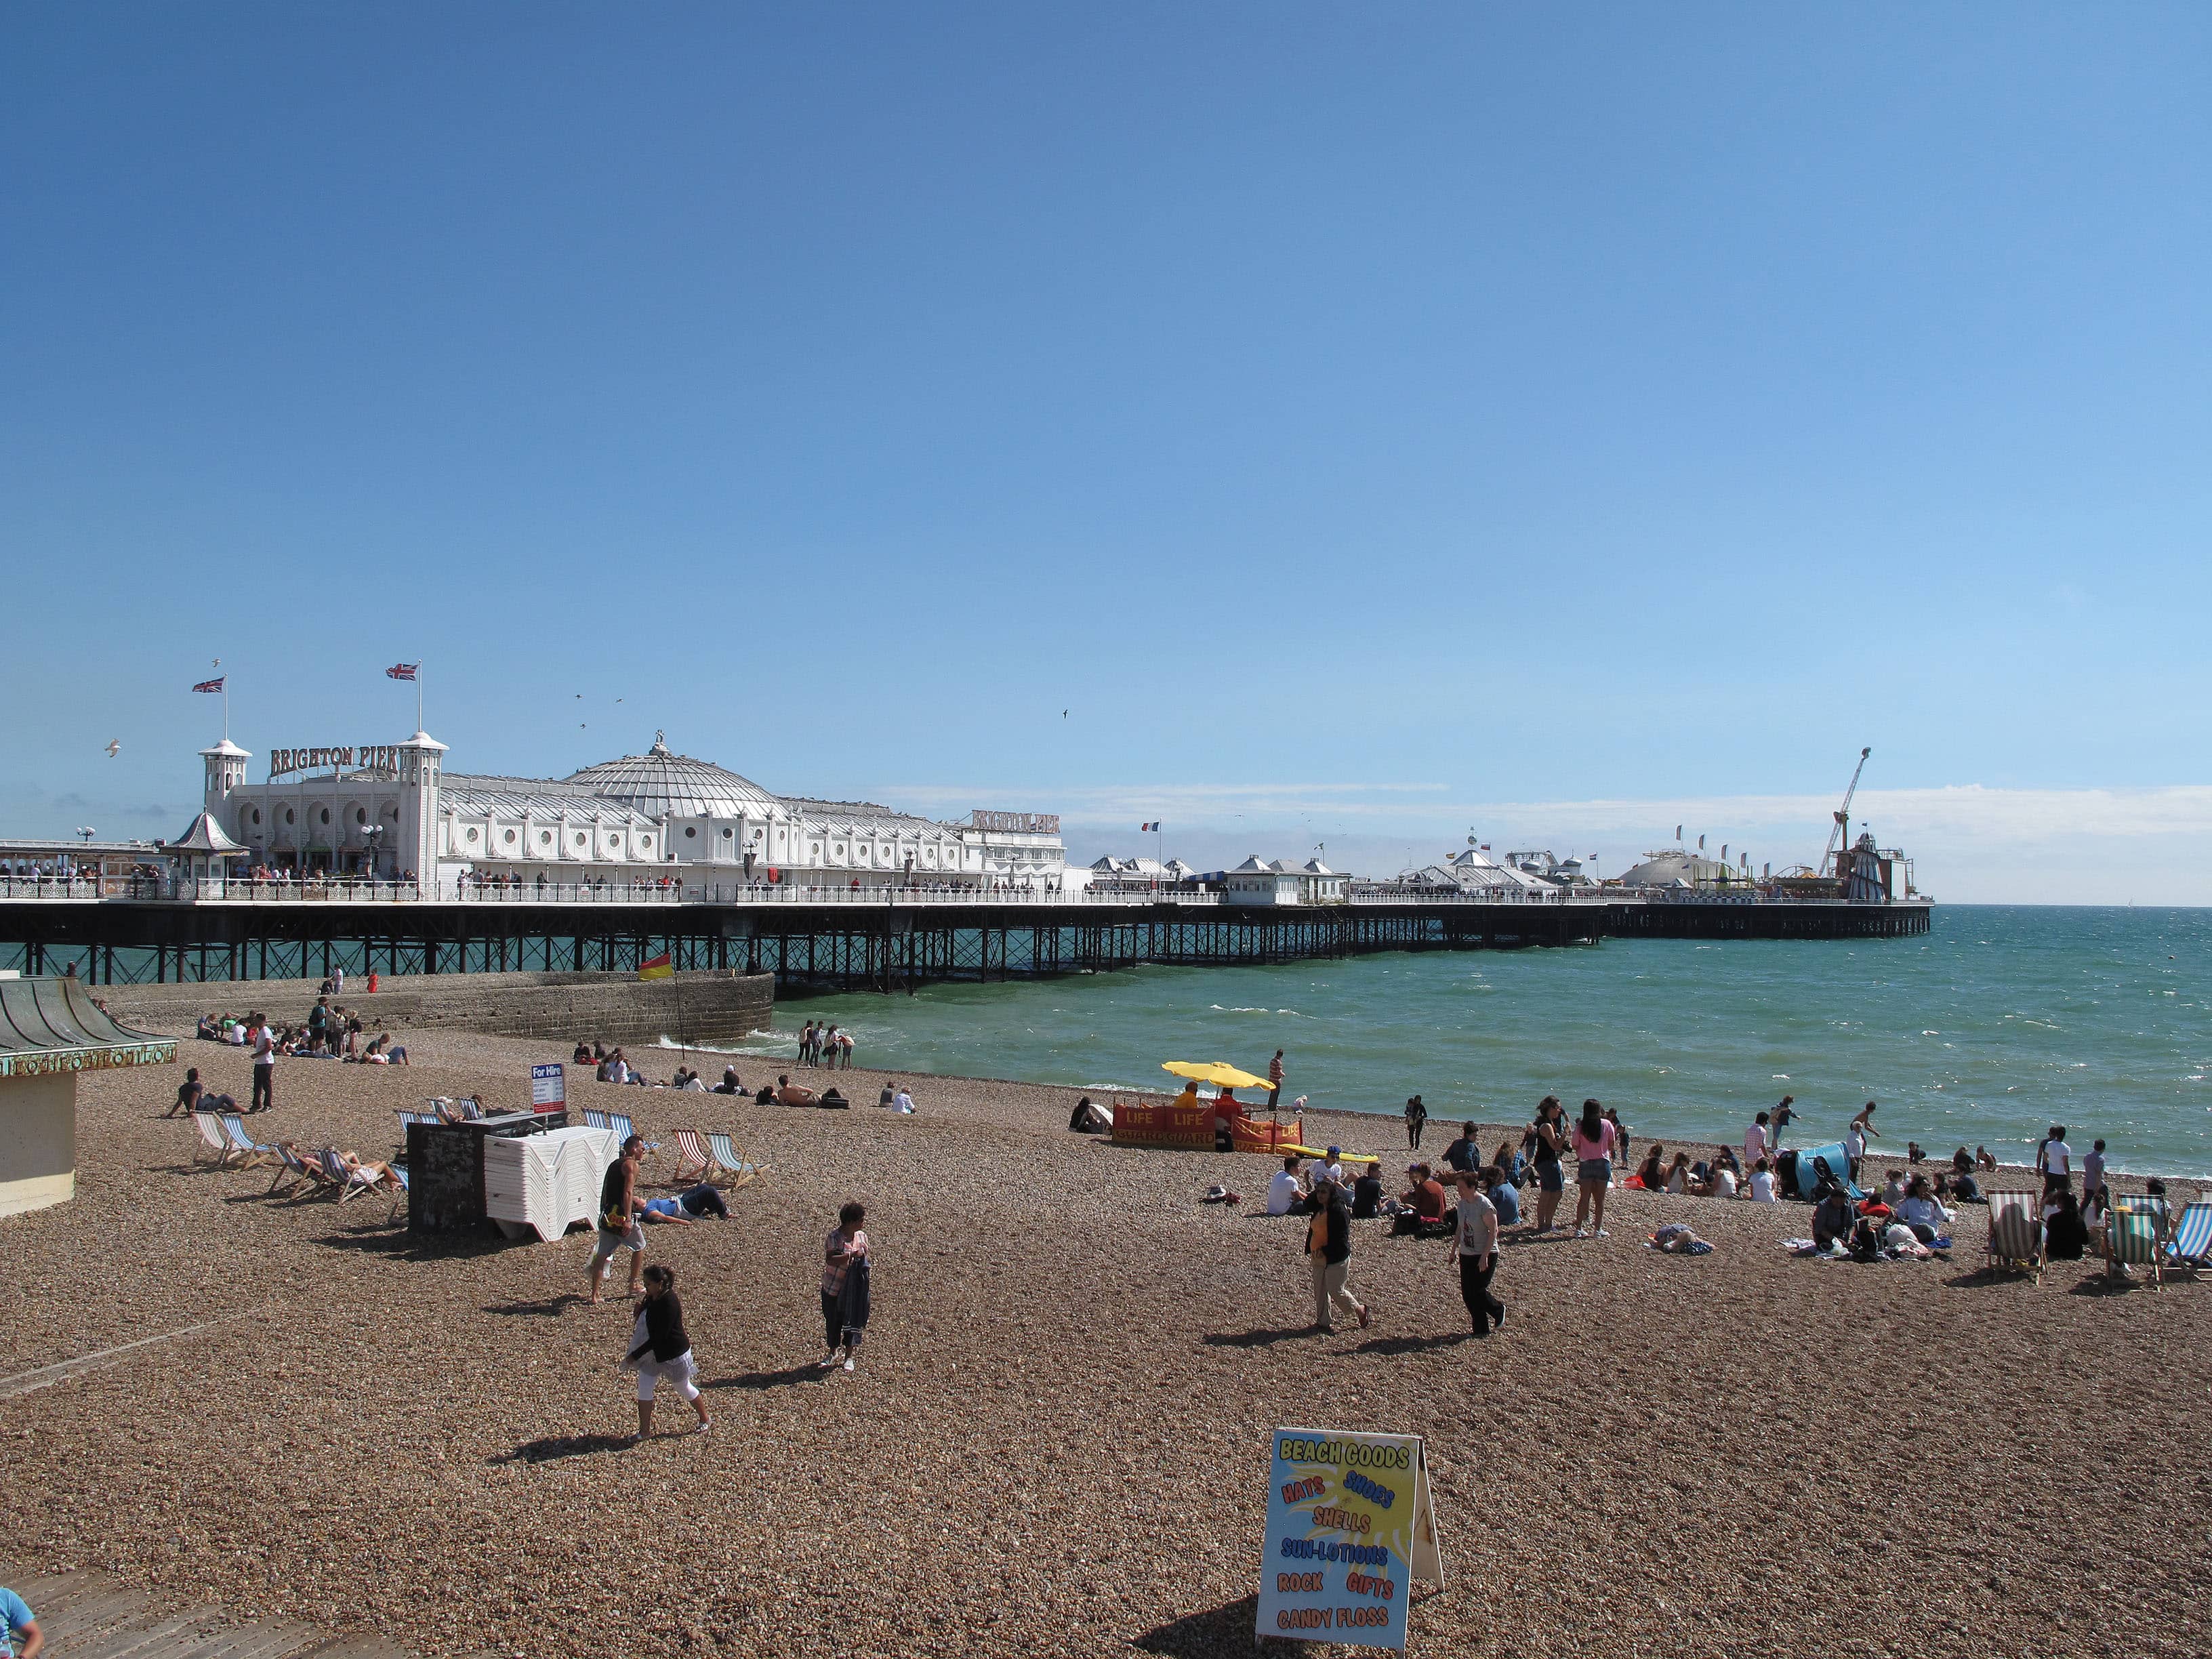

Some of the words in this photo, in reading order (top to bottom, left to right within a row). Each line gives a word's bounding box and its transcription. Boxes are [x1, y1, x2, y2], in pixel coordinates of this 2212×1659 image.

[271, 747, 354, 777] BRIGHTON
[360, 746, 398, 774] PIER
[972, 810, 1031, 832] BRIGHTON
[1035, 814, 1061, 834] PIER
[533, 1067, 545, 1078] For
[546, 1065, 561, 1076] Hire
[1126, 1111, 1153, 1124] LIFE
[1174, 1113, 1204, 1126] LIFE
[1118, 1130, 1164, 1141] GUARD
[1166, 1132, 1215, 1144] GUARD
[1279, 1438, 1342, 1464] BEACH
[1345, 1442, 1410, 1469] GOODS
[1281, 1475, 1326, 1504] HATS
[1343, 1469, 1395, 1509] SHOES
[1312, 1505, 1371, 1534] SHELLS
[1280, 1538, 1388, 1567] SUN-LOTIONS
[1277, 1572, 1324, 1593] ROCK
[1347, 1572, 1394, 1600] GIFTS
[1277, 1607, 1333, 1629] CANDY
[1336, 1606, 1389, 1628] FLOSS
